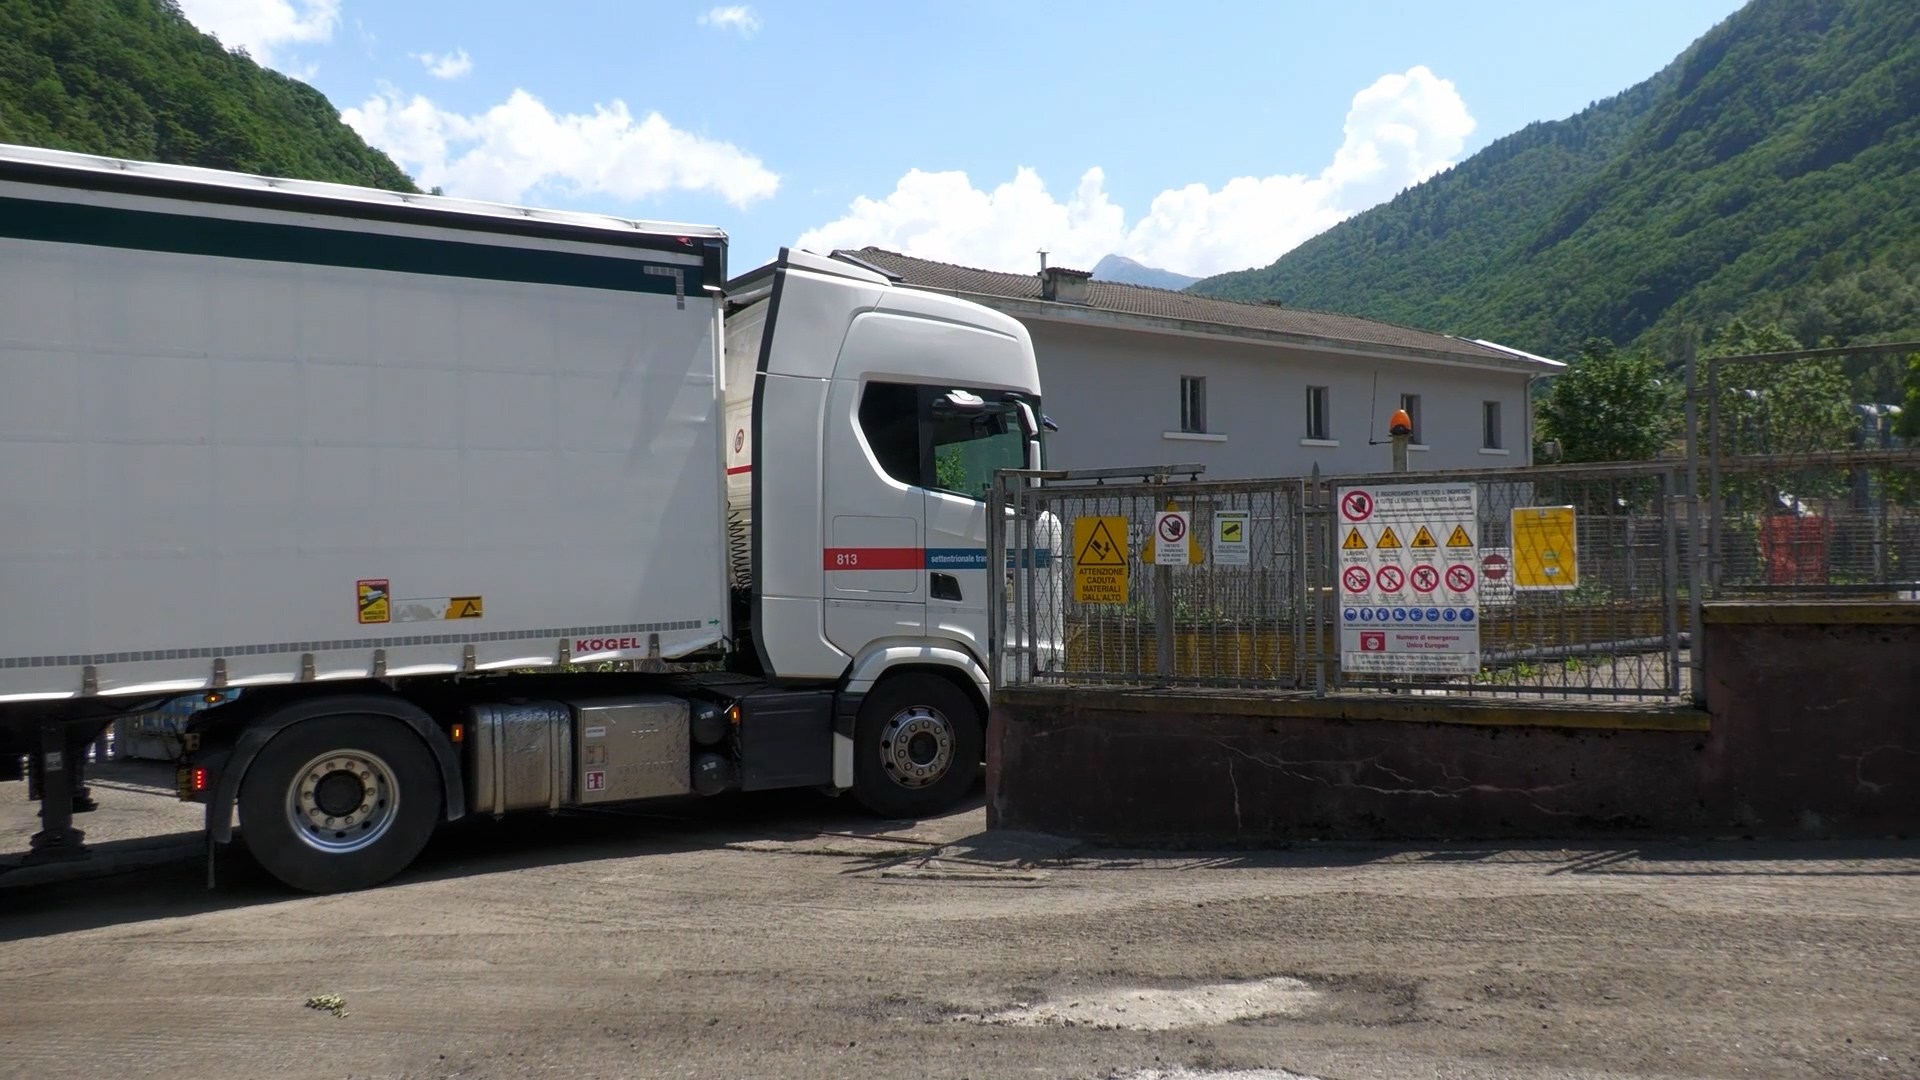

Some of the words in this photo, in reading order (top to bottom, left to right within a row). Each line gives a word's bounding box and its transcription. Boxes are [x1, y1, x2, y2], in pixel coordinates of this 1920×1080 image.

[836, 554, 858, 565] 813
[931, 555, 974, 563] settentrionale
[576, 638, 640, 652] KÖGEL
